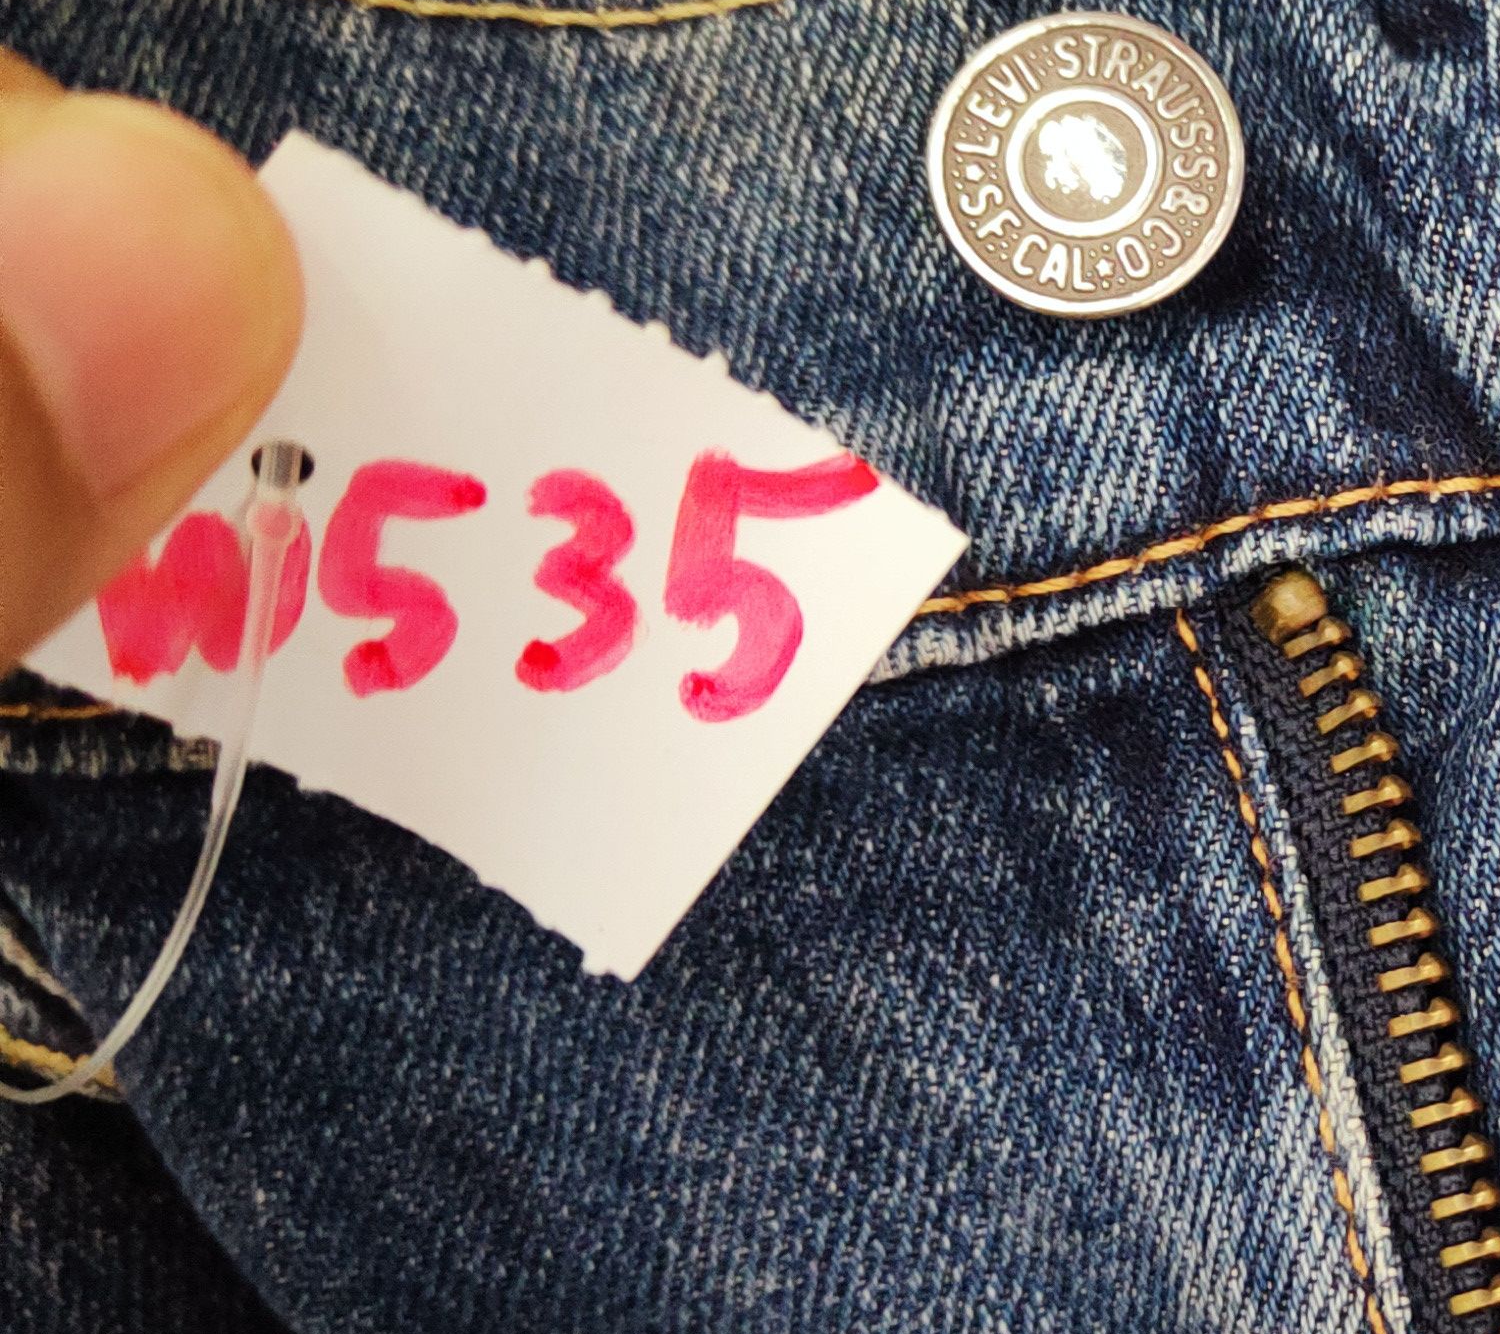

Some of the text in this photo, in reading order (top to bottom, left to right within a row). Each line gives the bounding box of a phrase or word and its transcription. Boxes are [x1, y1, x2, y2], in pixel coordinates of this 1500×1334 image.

[954, 52, 1042, 157] LEVI
[1053, 34, 1219, 179] STRAUSS
[1159, 183, 1211, 217] &
[1012, 233, 1097, 292] CAL
